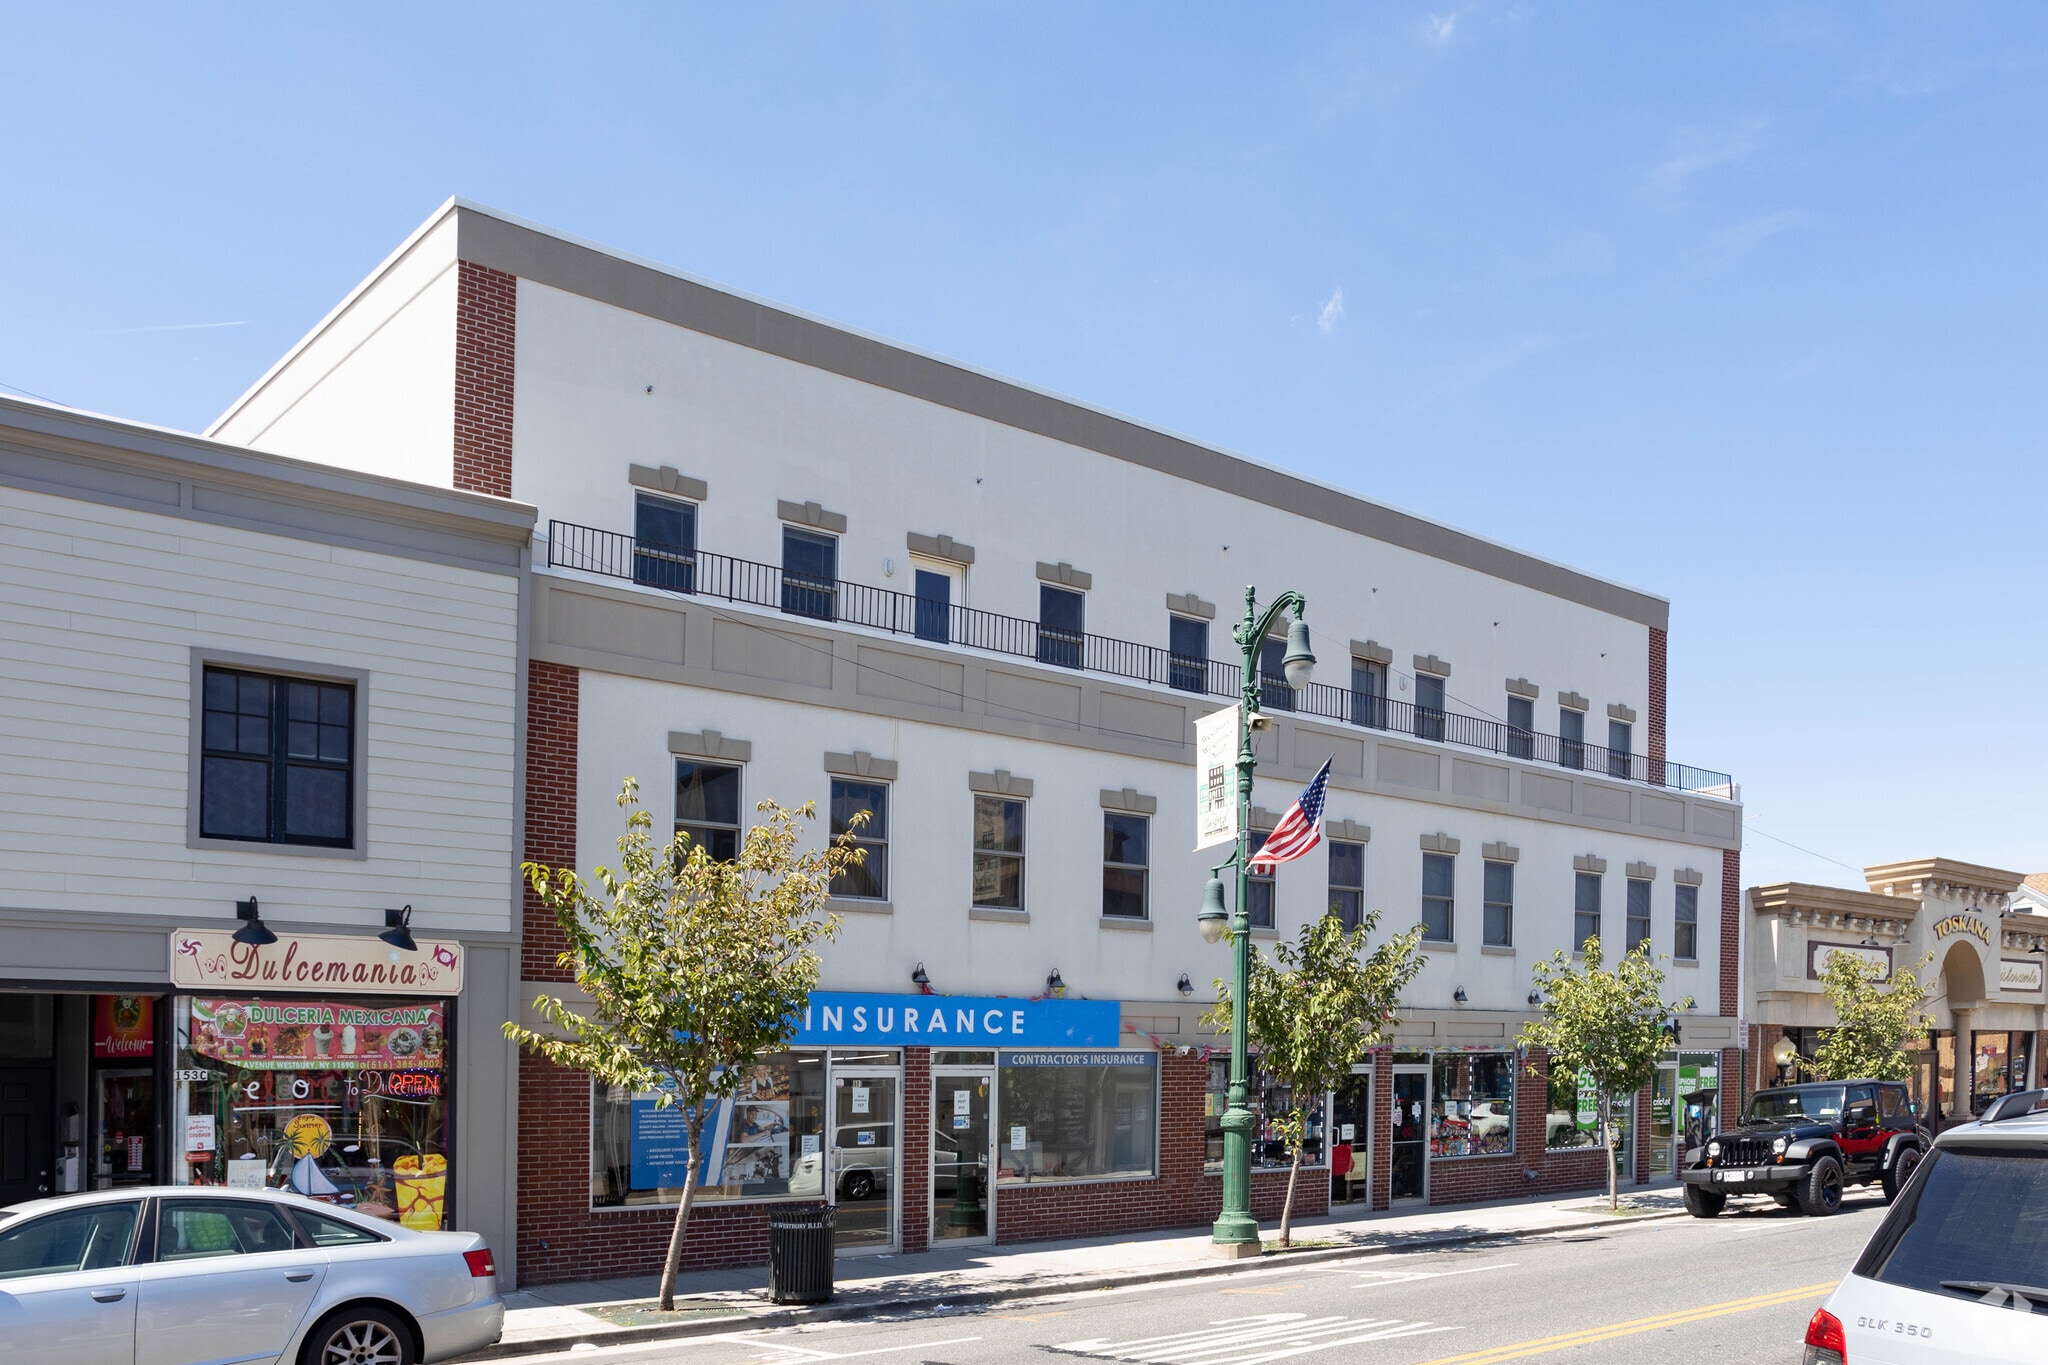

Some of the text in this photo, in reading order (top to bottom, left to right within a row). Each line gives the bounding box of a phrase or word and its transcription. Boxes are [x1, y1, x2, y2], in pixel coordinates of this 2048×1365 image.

[1933, 915, 1991, 946] TOSKANA
[230, 940, 417, 985] Dulcemania
[251, 1006, 334, 1024] DULCERIA
[337, 1008, 429, 1025] MEXICANA
[805, 1006, 1025, 1034] INSURANCE
[106, 1034, 148, 1053] Welcome
[243, 1061, 275, 1069] AVENUE
[367, 1060, 440, 1069] (516) 385-8002
[1012, 1054, 1145, 1065] CONTRACTOR'S INSURANCE
[175, 1070, 208, 1081] 153C
[390, 1074, 440, 1090] OPEN
[1700, 1077, 1717, 1088] FREE
[1577, 1099, 1597, 1112] FREE
[1691, 1107, 1699, 1118] P
[1857, 1316, 1933, 1339] GLK 350
